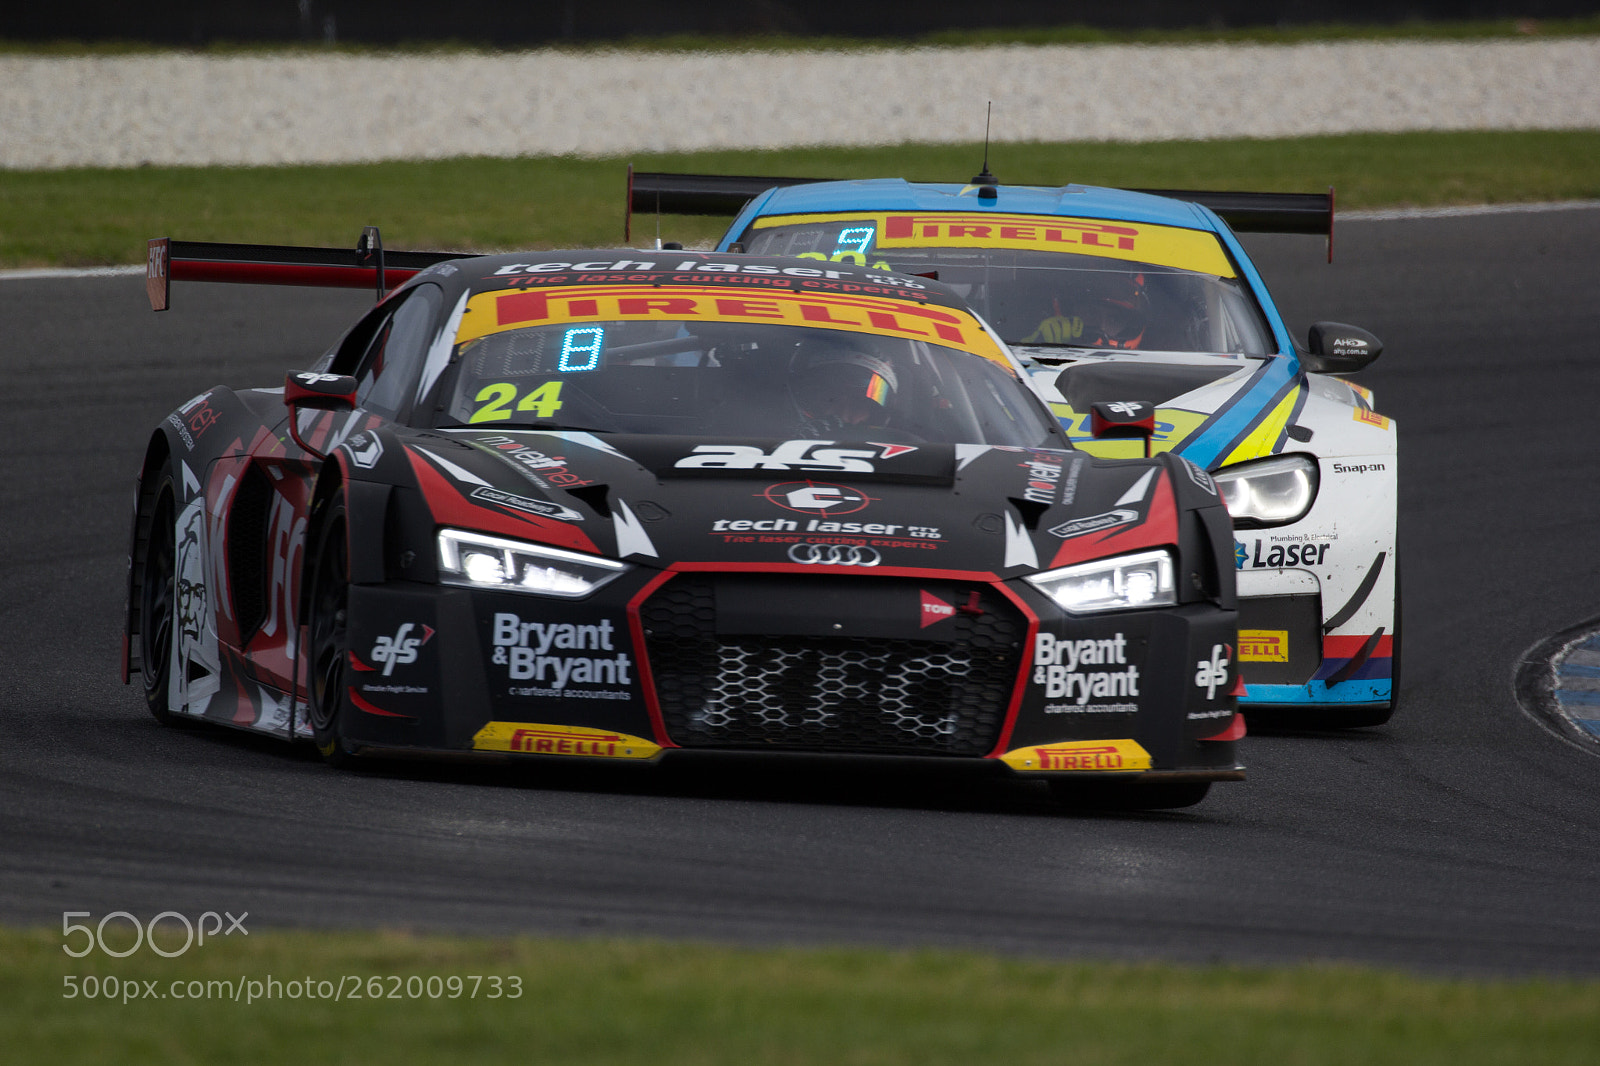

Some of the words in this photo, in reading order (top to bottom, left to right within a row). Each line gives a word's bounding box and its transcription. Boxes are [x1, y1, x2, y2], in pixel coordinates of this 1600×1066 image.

[885, 216, 1139, 250] PIRELLI
[148, 245, 166, 279] KFC
[494, 260, 657, 276] tech
[675, 260, 854, 279] laser
[507, 275, 569, 286] The
[577, 274, 664, 283] laser
[672, 273, 792, 287] cutting
[801, 279, 929, 300] experts
[496, 285, 966, 345] PIRELLI
[557, 327, 604, 372] 8
[1333, 347, 1368, 356] ahg.com.au
[469, 381, 564, 423] 24
[674, 440, 876, 473] afs
[1333, 463, 1385, 474] Snap-on
[712, 518, 798, 532] tech
[806, 519, 903, 535] laser
[911, 531, 942, 539] LTD
[1270, 534, 1303, 542] Plumbing
[723, 534, 753, 543] The
[757, 534, 806, 543] laser
[813, 536, 868, 548] cutting
[870, 538, 938, 550] experts
[1252, 538, 1331, 568] Laser
[922, 603, 954, 615] TOW
[493, 612, 614, 655] Bryant
[1238, 636, 1281, 656] ELLI
[371, 623, 421, 676] afs
[1034, 633, 1126, 672] Bryant
[1195, 644, 1229, 700] afs
[509, 687, 562, 698] chartered
[563, 687, 632, 700] accountants
[1044, 703, 1086, 713] chartered
[1086, 702, 1139, 712] accountants
[509, 729, 620, 756] PIRELLI
[1034, 746, 1123, 769] PIRELLI
